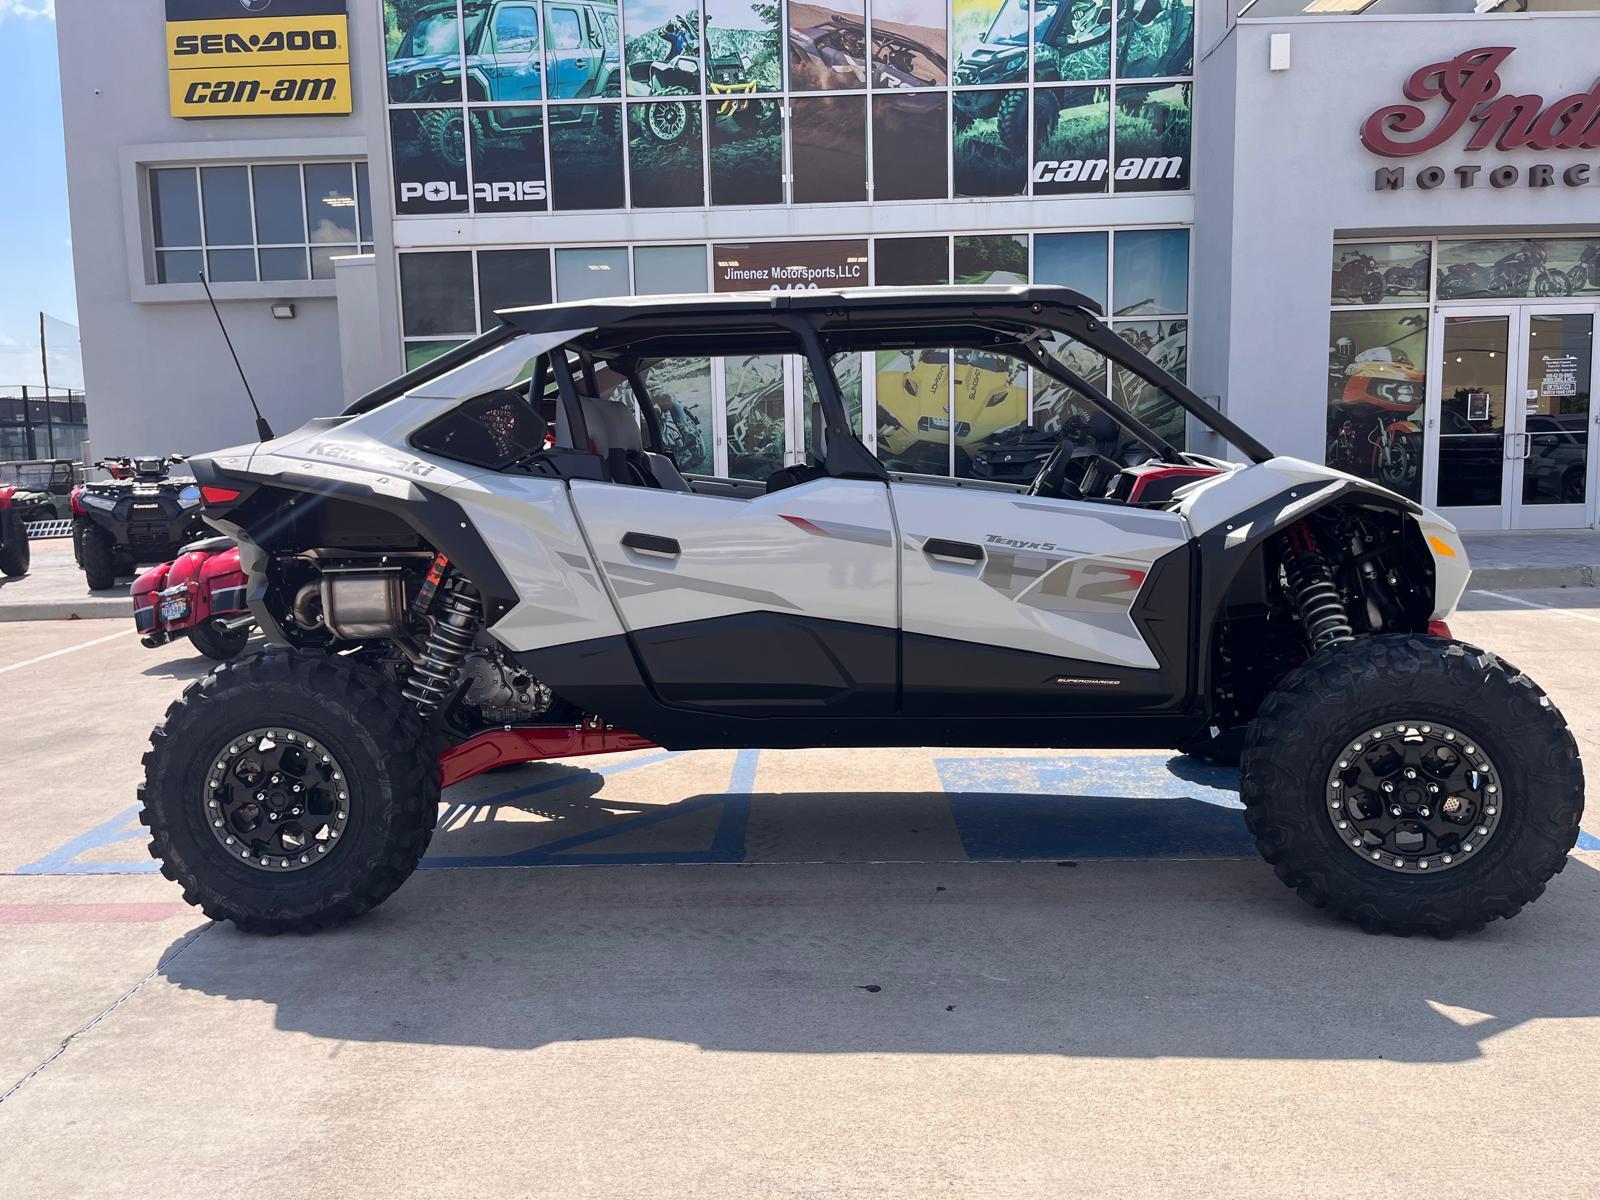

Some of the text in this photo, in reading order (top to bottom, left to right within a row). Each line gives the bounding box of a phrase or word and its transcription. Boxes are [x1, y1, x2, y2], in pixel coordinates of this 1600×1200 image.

[184, 78, 336, 104] can-am
[1375, 164, 1600, 191] MOTORC
[400, 180, 547, 202] POLARIS
[724, 267, 769, 280] Jimenez
[1057, 678, 1121, 686] SUPERCHARGED
